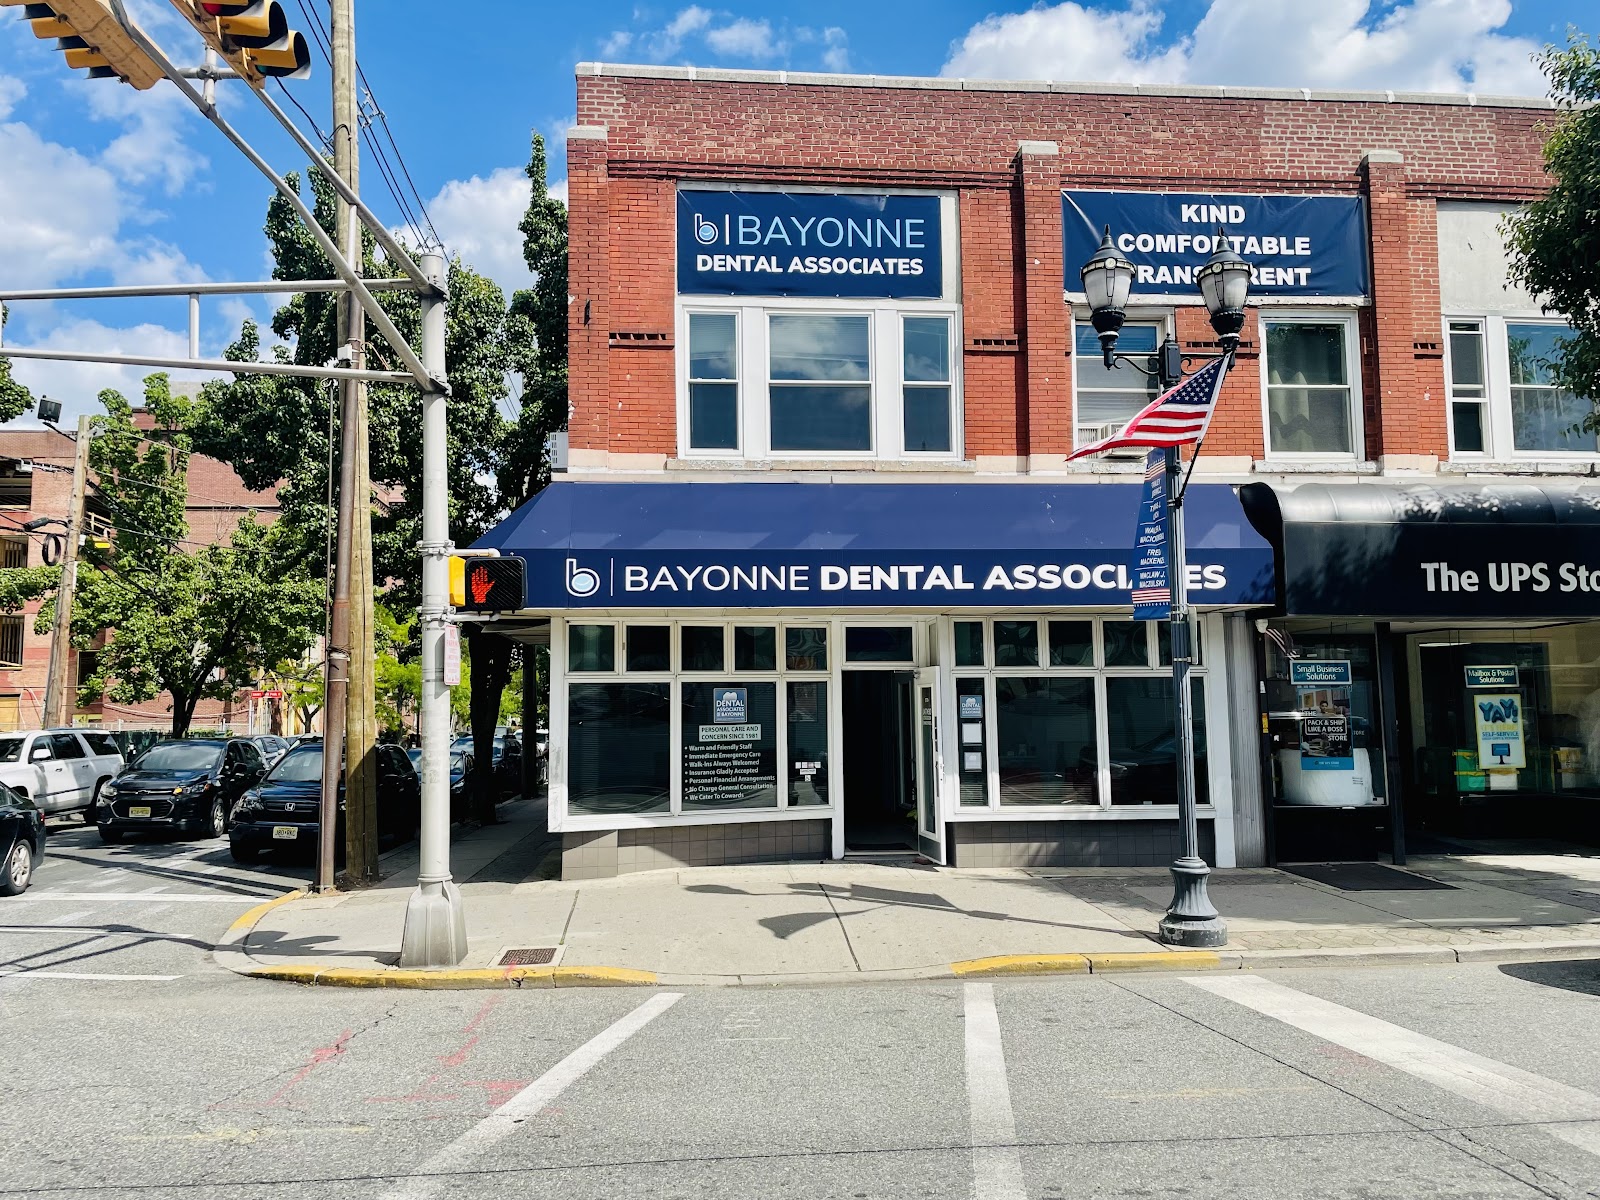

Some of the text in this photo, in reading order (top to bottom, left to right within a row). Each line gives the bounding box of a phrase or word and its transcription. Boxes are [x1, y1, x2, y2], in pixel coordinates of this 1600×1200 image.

[1182, 204, 1246, 224] KIND
[738, 215, 925, 248] BAYONNE
[696, 254, 924, 276] DENTAL ASSOCIATES
[1137, 265, 1312, 286] RANSRENT
[625, 565, 810, 592] BAYONNE
[820, 565, 974, 591] DENTAL
[983, 564, 1226, 590] ASSOCIES
[1421, 562, 1479, 592] The
[1488, 562, 1550, 592] UPS
[1479, 698, 1518, 723] YAY!
[734, 767, 759, 775] Accepted
